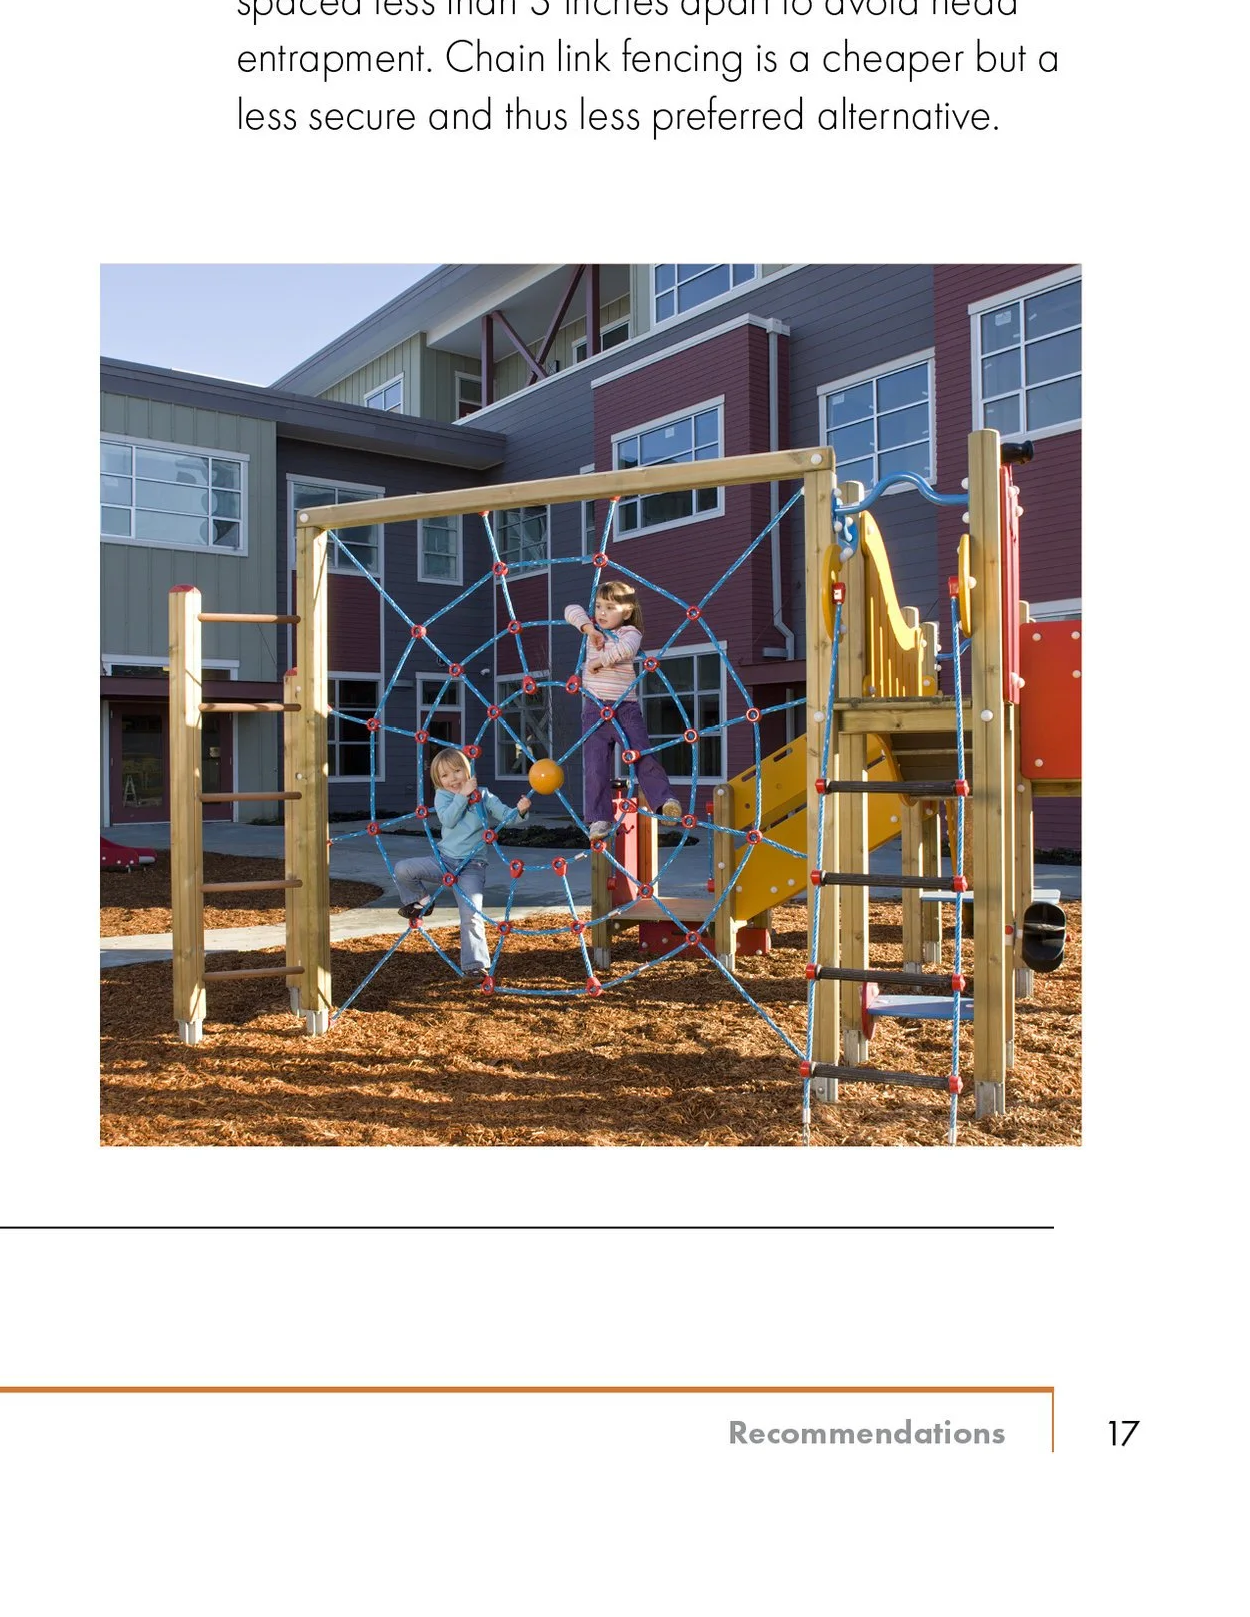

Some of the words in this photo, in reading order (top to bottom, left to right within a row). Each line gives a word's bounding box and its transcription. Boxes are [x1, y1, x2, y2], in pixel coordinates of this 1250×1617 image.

[238, 95, 297, 131] less
[308, 108, 416, 131] secure
[428, 95, 492, 131] and
[505, 95, 568, 131] thus
[580, 95, 640, 131] less
[653, 94, 803, 141] preferred
[817, 95, 999, 131] alternative.
[729, 1418, 1006, 1444] Recommendations
[1108, 1420, 1141, 1447] 17
